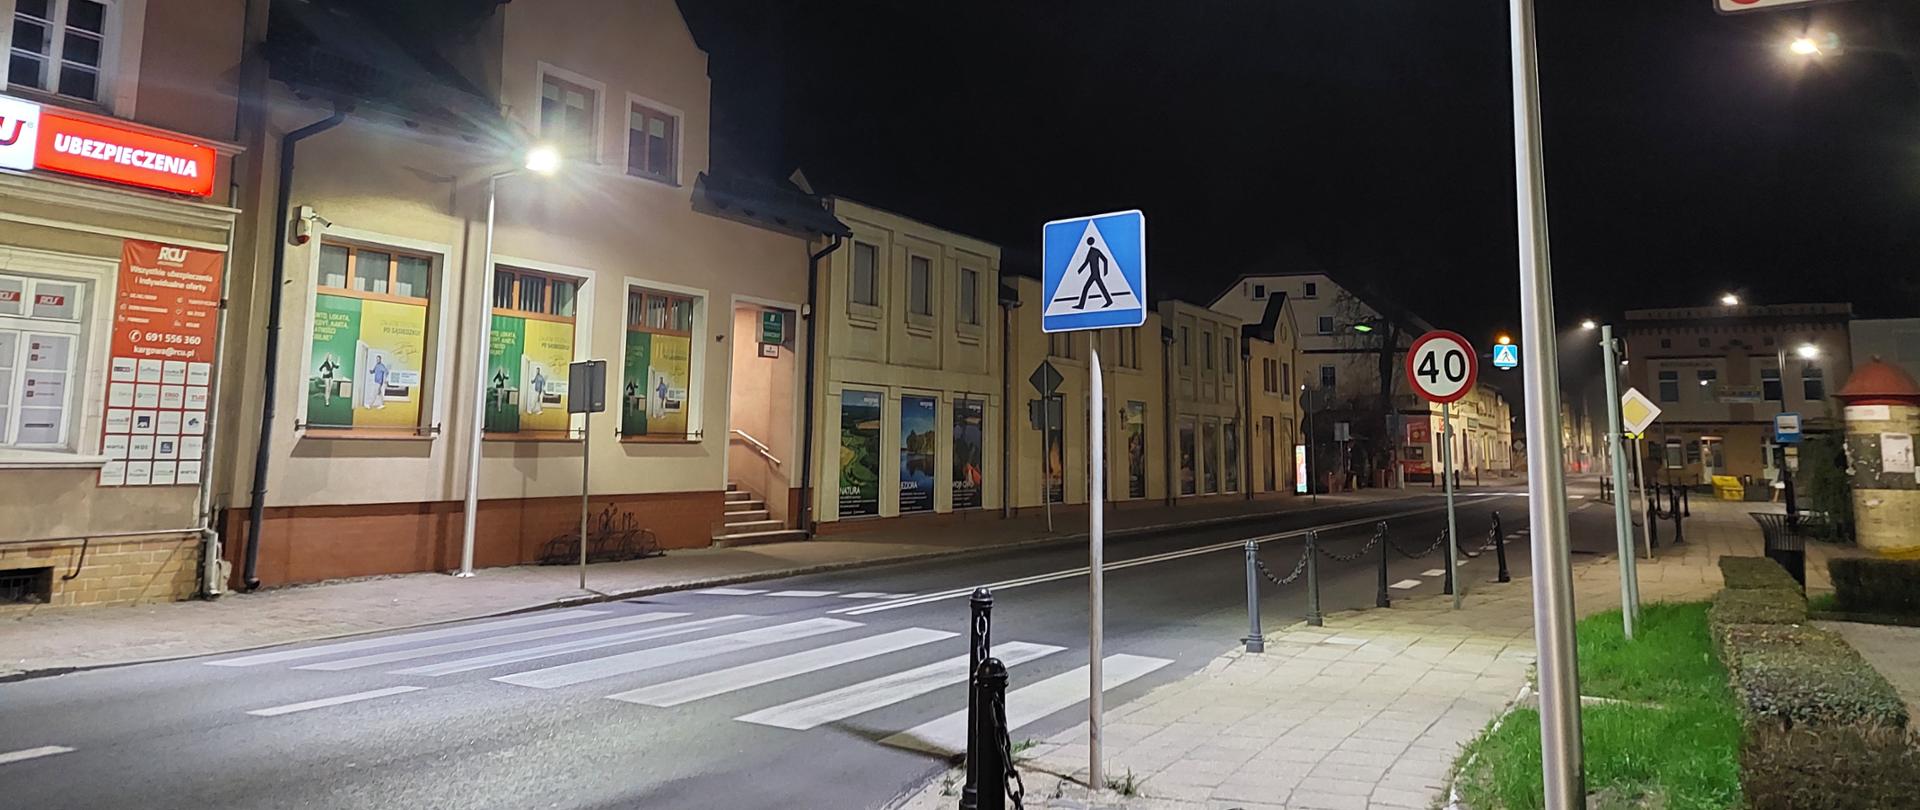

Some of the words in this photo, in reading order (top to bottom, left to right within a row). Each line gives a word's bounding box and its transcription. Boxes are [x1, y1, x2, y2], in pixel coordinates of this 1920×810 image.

[54, 133, 197, 178] UBEZPIECZENIA
[158, 246, 189, 263] RCU
[130, 265, 166, 277] Wszystkie
[167, 270, 213, 282] ubezpieczenia
[139, 276, 185, 288] indywidualne
[186, 282, 207, 293] oferty
[145, 332, 163, 342] 691
[165, 334, 182, 344] 556
[184, 335, 201, 345] 360
[1417, 349, 1466, 384] 40
